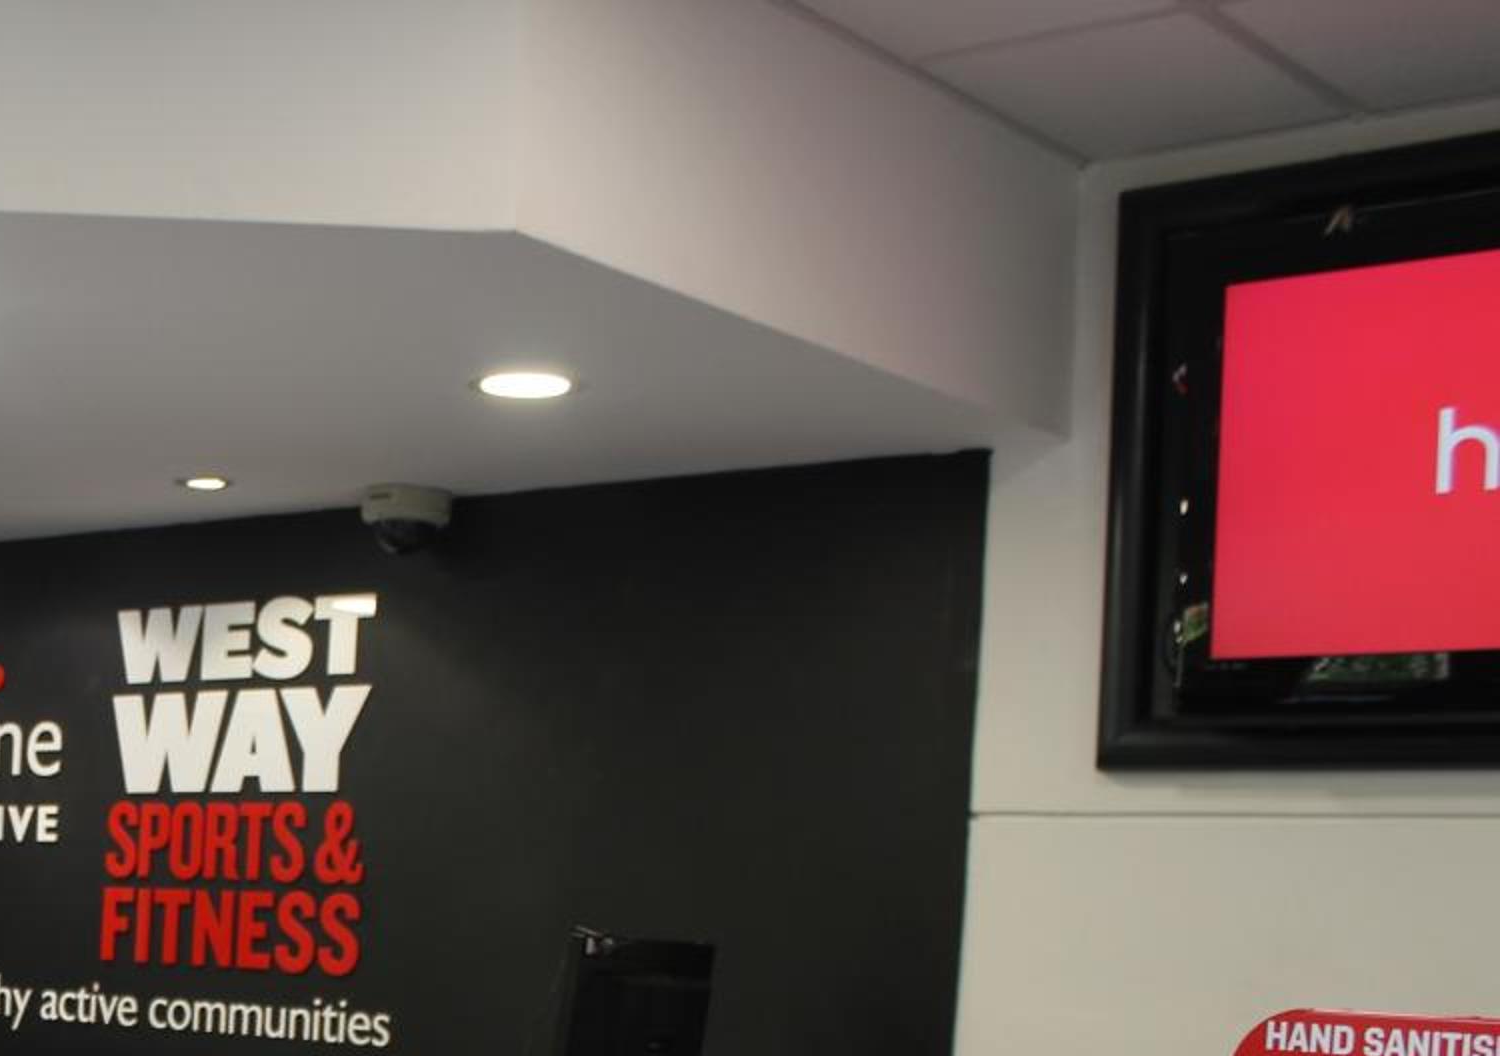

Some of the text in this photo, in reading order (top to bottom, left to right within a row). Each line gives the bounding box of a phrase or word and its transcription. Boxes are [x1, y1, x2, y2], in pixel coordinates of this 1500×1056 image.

[117, 592, 377, 685] WEST
[112, 684, 373, 794] WAY
[104, 801, 365, 884] SPORTS &
[99, 887, 362, 976] FITNESS
[39, 982, 139, 1027] active
[148, 995, 392, 1049] communities
[1265, 1020, 1356, 1056] HAND
